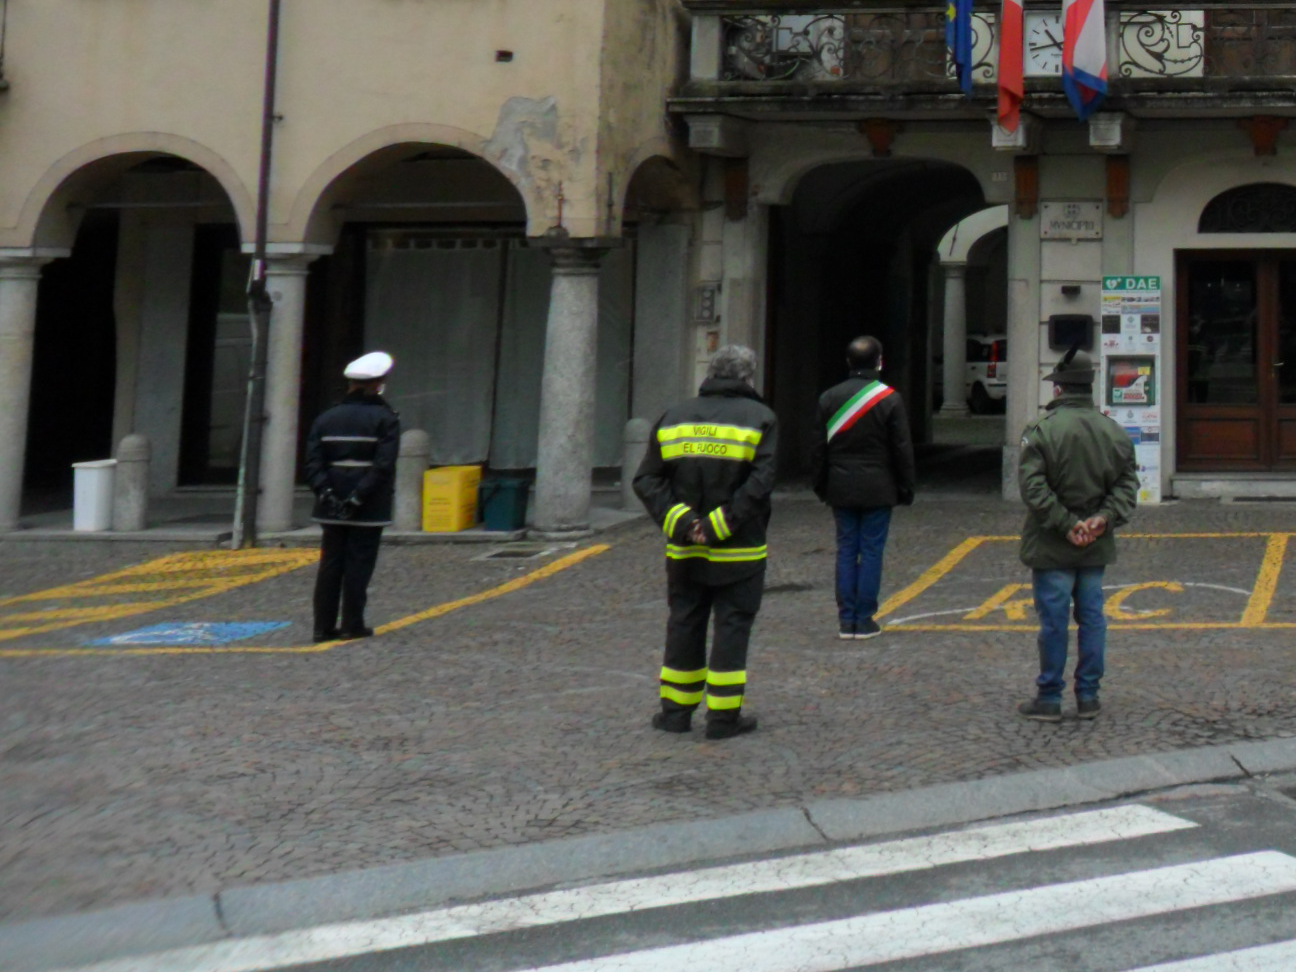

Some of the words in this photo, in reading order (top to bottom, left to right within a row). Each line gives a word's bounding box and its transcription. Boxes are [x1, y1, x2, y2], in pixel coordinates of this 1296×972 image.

[1126, 278, 1157, 290] DAE
[693, 426, 717, 436] VIGILI
[697, 443, 727, 454] FUOCO
